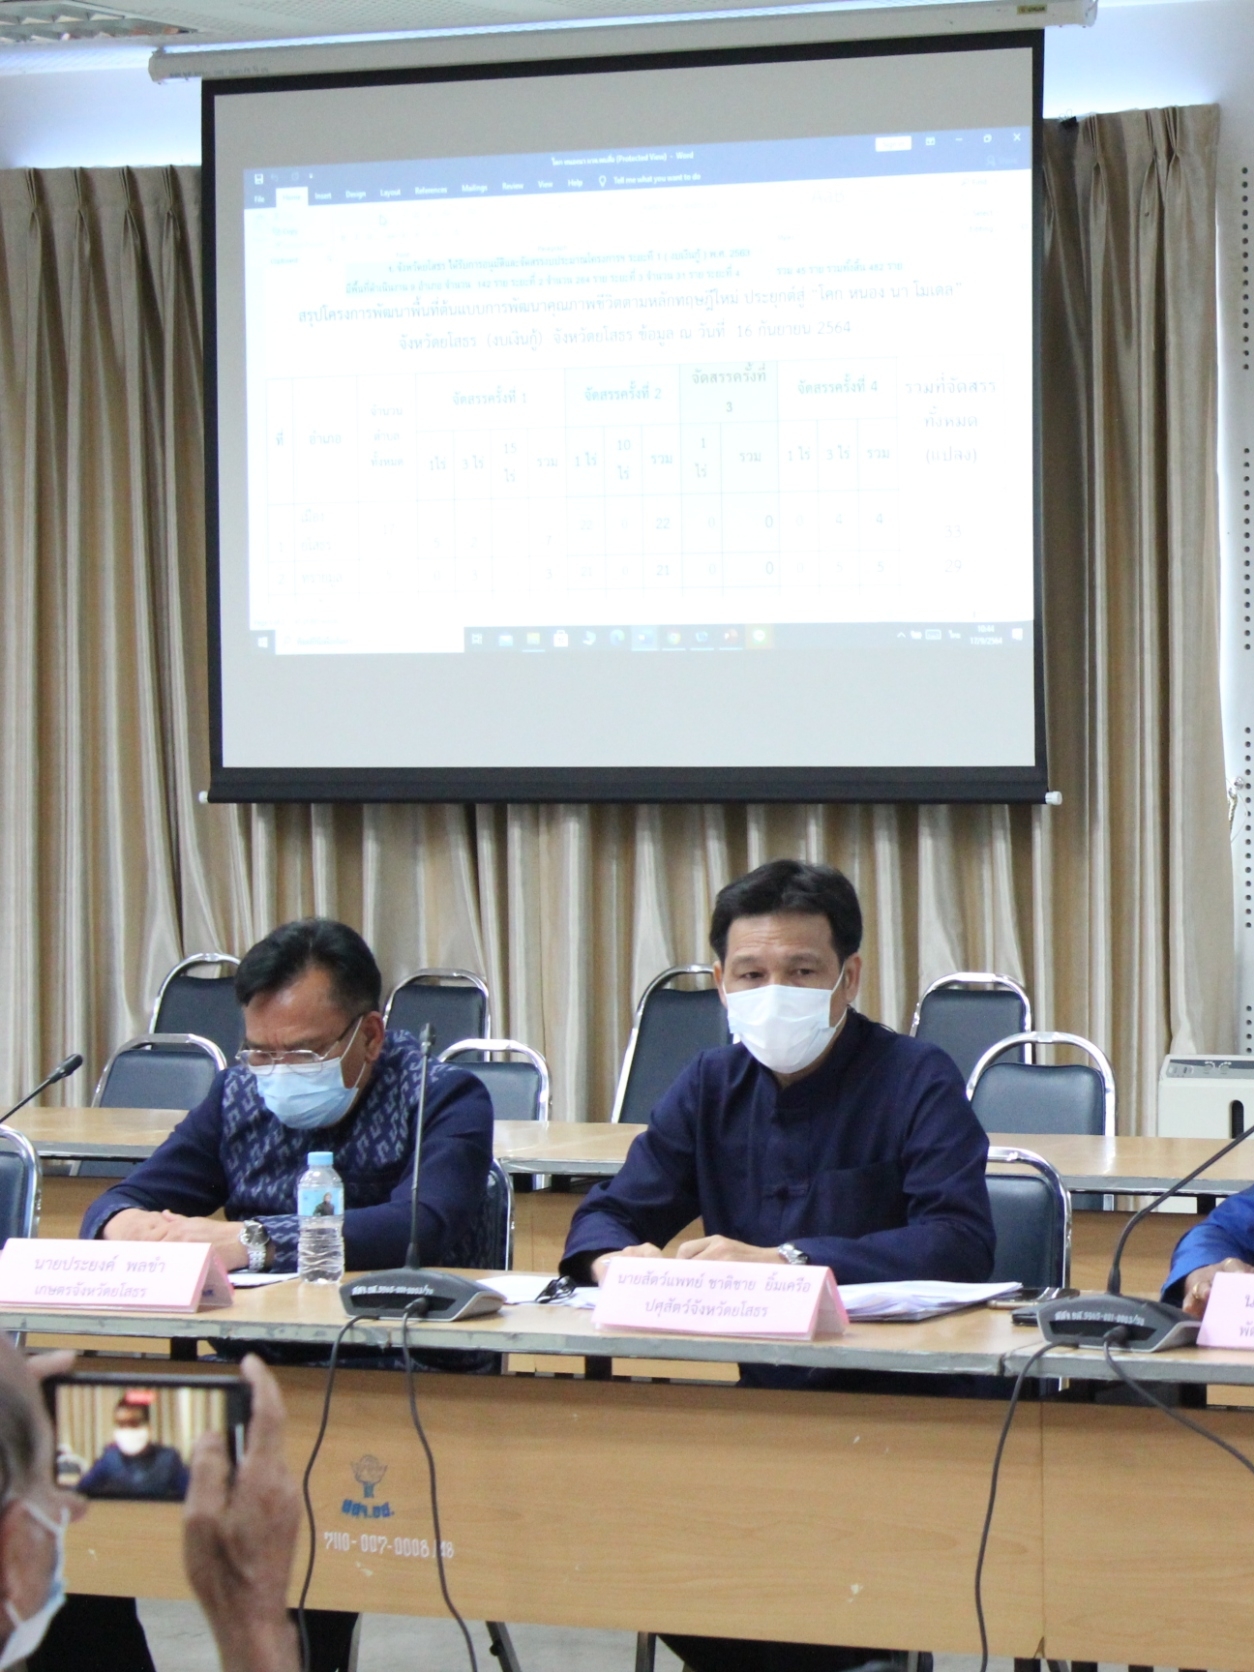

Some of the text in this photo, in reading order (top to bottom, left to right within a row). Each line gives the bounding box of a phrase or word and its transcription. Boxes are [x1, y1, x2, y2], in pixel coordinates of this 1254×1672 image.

[675, 151, 695, 160] Word
[538, 180, 553, 189] View
[567, 178, 584, 188] Help
[614, 176, 625, 184] Tell
[637, 175, 653, 183] what
[653, 176, 667, 185] you
[667, 174, 683, 182] want
[415, 185, 448, 195] References
[461, 183, 488, 194] Mailings
[502, 181, 524, 191] Review
[315, 192, 332, 200] Insert
[346, 189, 366, 201] Design
[380, 187, 401, 198] Layout
[254, 195, 265, 203] File
[849, 284, 885, 300] หนอง
[891, 285, 909, 299] นา
[398, 330, 478, 351] จังหวัดยโสธร
[552, 325, 633, 346] จังหวัดยโสธร
[638, 323, 674, 347] ข้อมูล
[680, 328, 693, 340] ณ
[698, 317, 726, 339] วันที่
[737, 324, 752, 338] 16
[758, 319, 811, 338] กันยายน
[817, 320, 852, 335] 2564
[691, 361, 767, 386] จัดสรรครั้งที่
[797, 372, 866, 395] จัดสรรครั้งที่
[452, 384, 517, 406] จัดสรรครั้งที่
[584, 378, 649, 402] จัดสรรครั้งที่
[34, 1255, 166, 1273] นายประยงค์ พลขำ
[709, 1273, 756, 1291] ชาติชาย
[764, 1271, 811, 1293] ยิ้มเครือ
[34, 1281, 147, 1298] เกษตรจังหวัดยโสธร
[645, 1298, 769, 1319] ปศุสัตว์จังหวัดยโสธร
